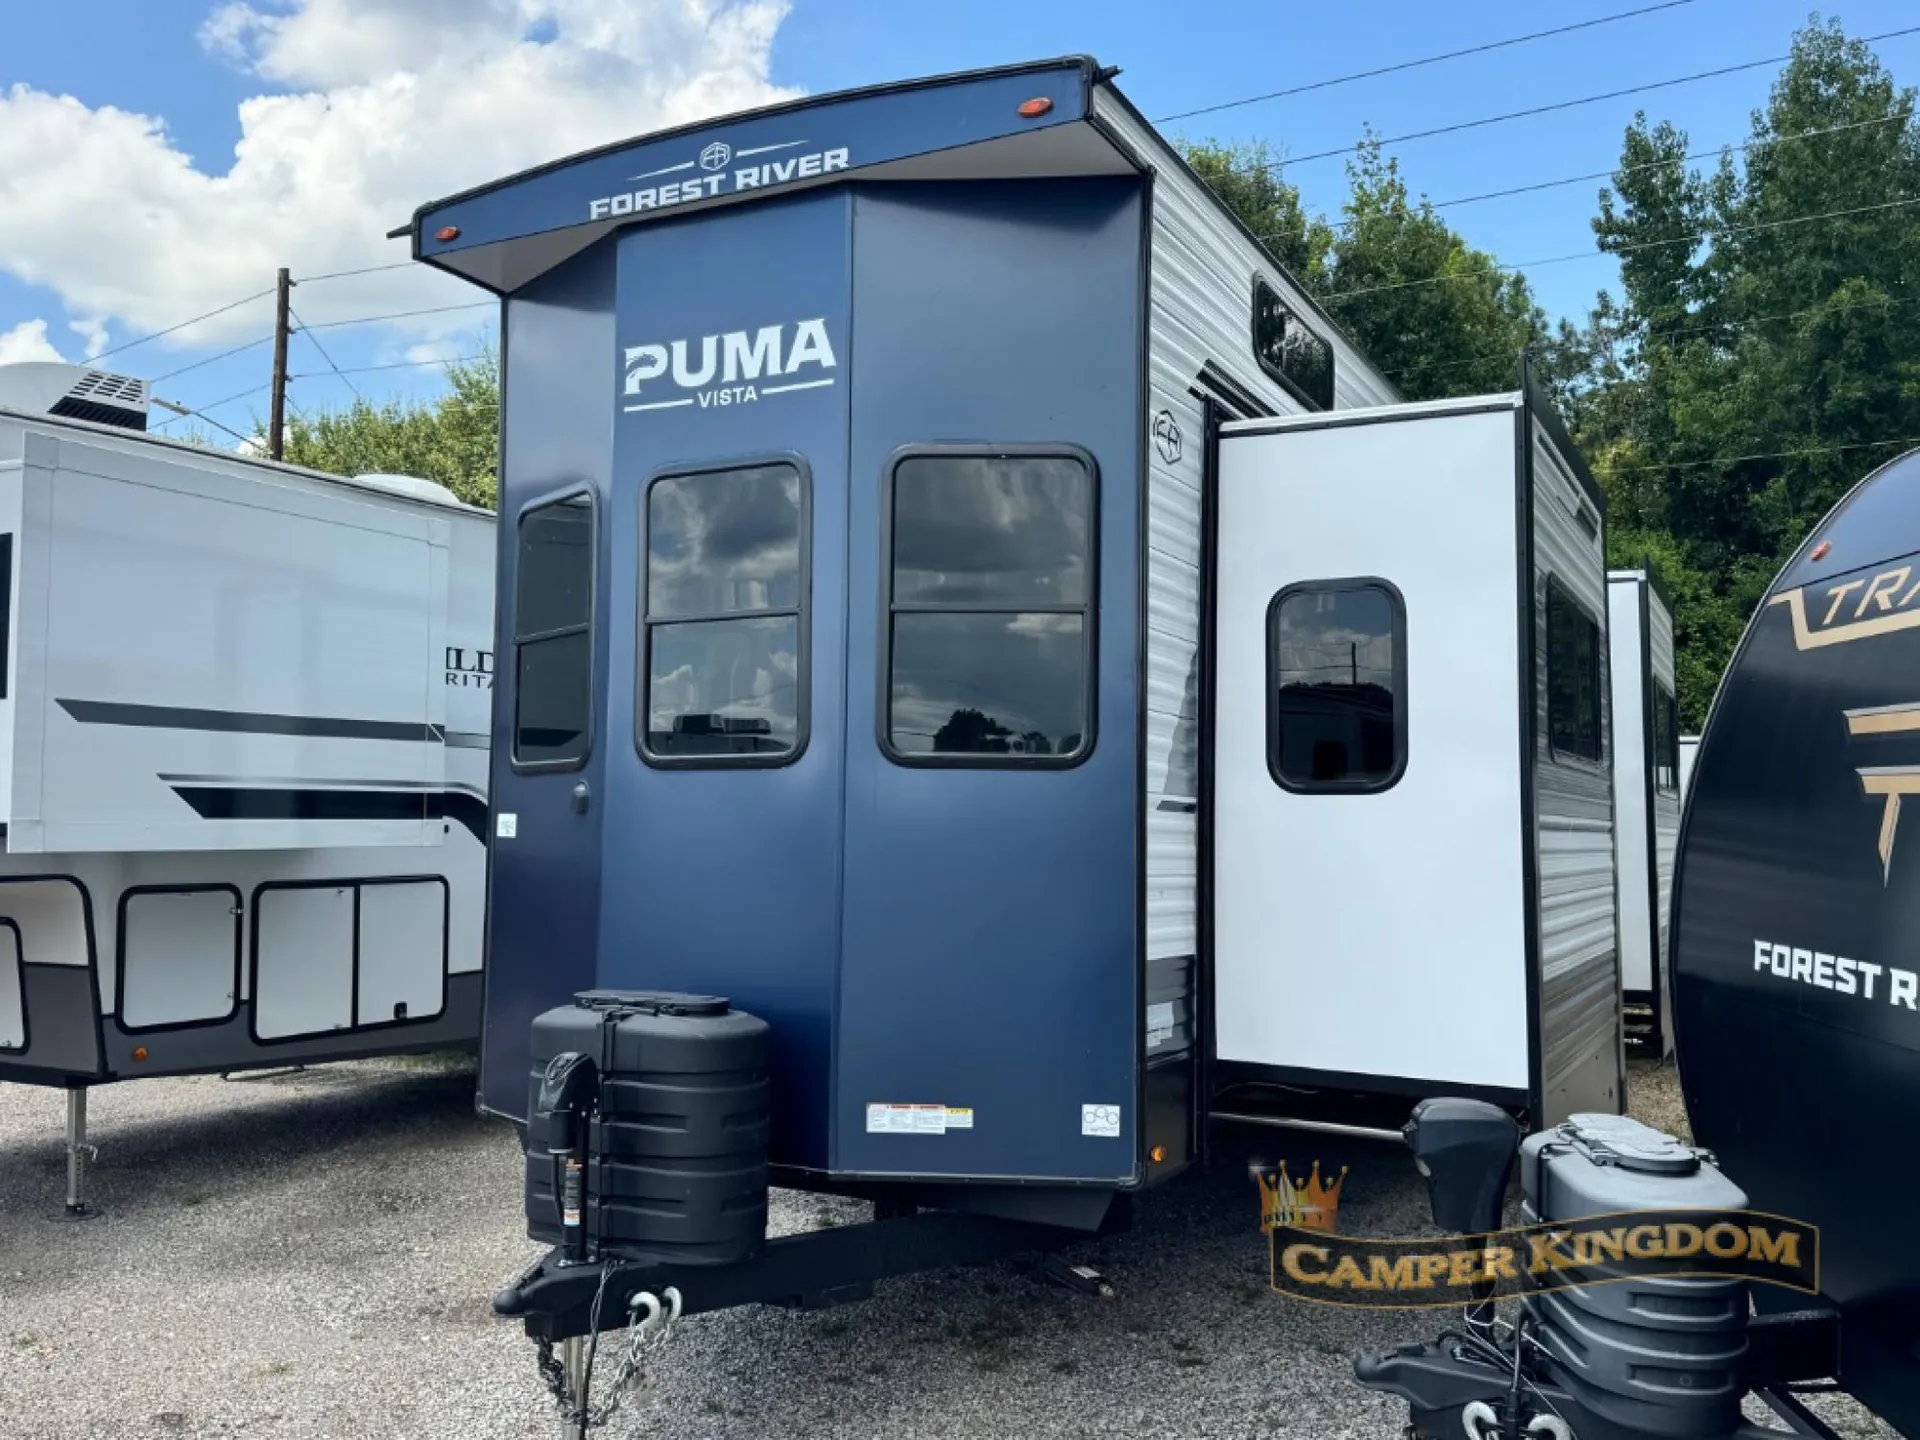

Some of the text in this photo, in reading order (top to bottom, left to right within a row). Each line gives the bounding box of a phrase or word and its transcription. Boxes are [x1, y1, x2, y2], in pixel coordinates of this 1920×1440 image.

[589, 147, 849, 221] FOREST RIVER
[623, 317, 837, 396] PUMA
[697, 385, 758, 408] VISTA
[1754, 938, 1882, 1000] FOREST
